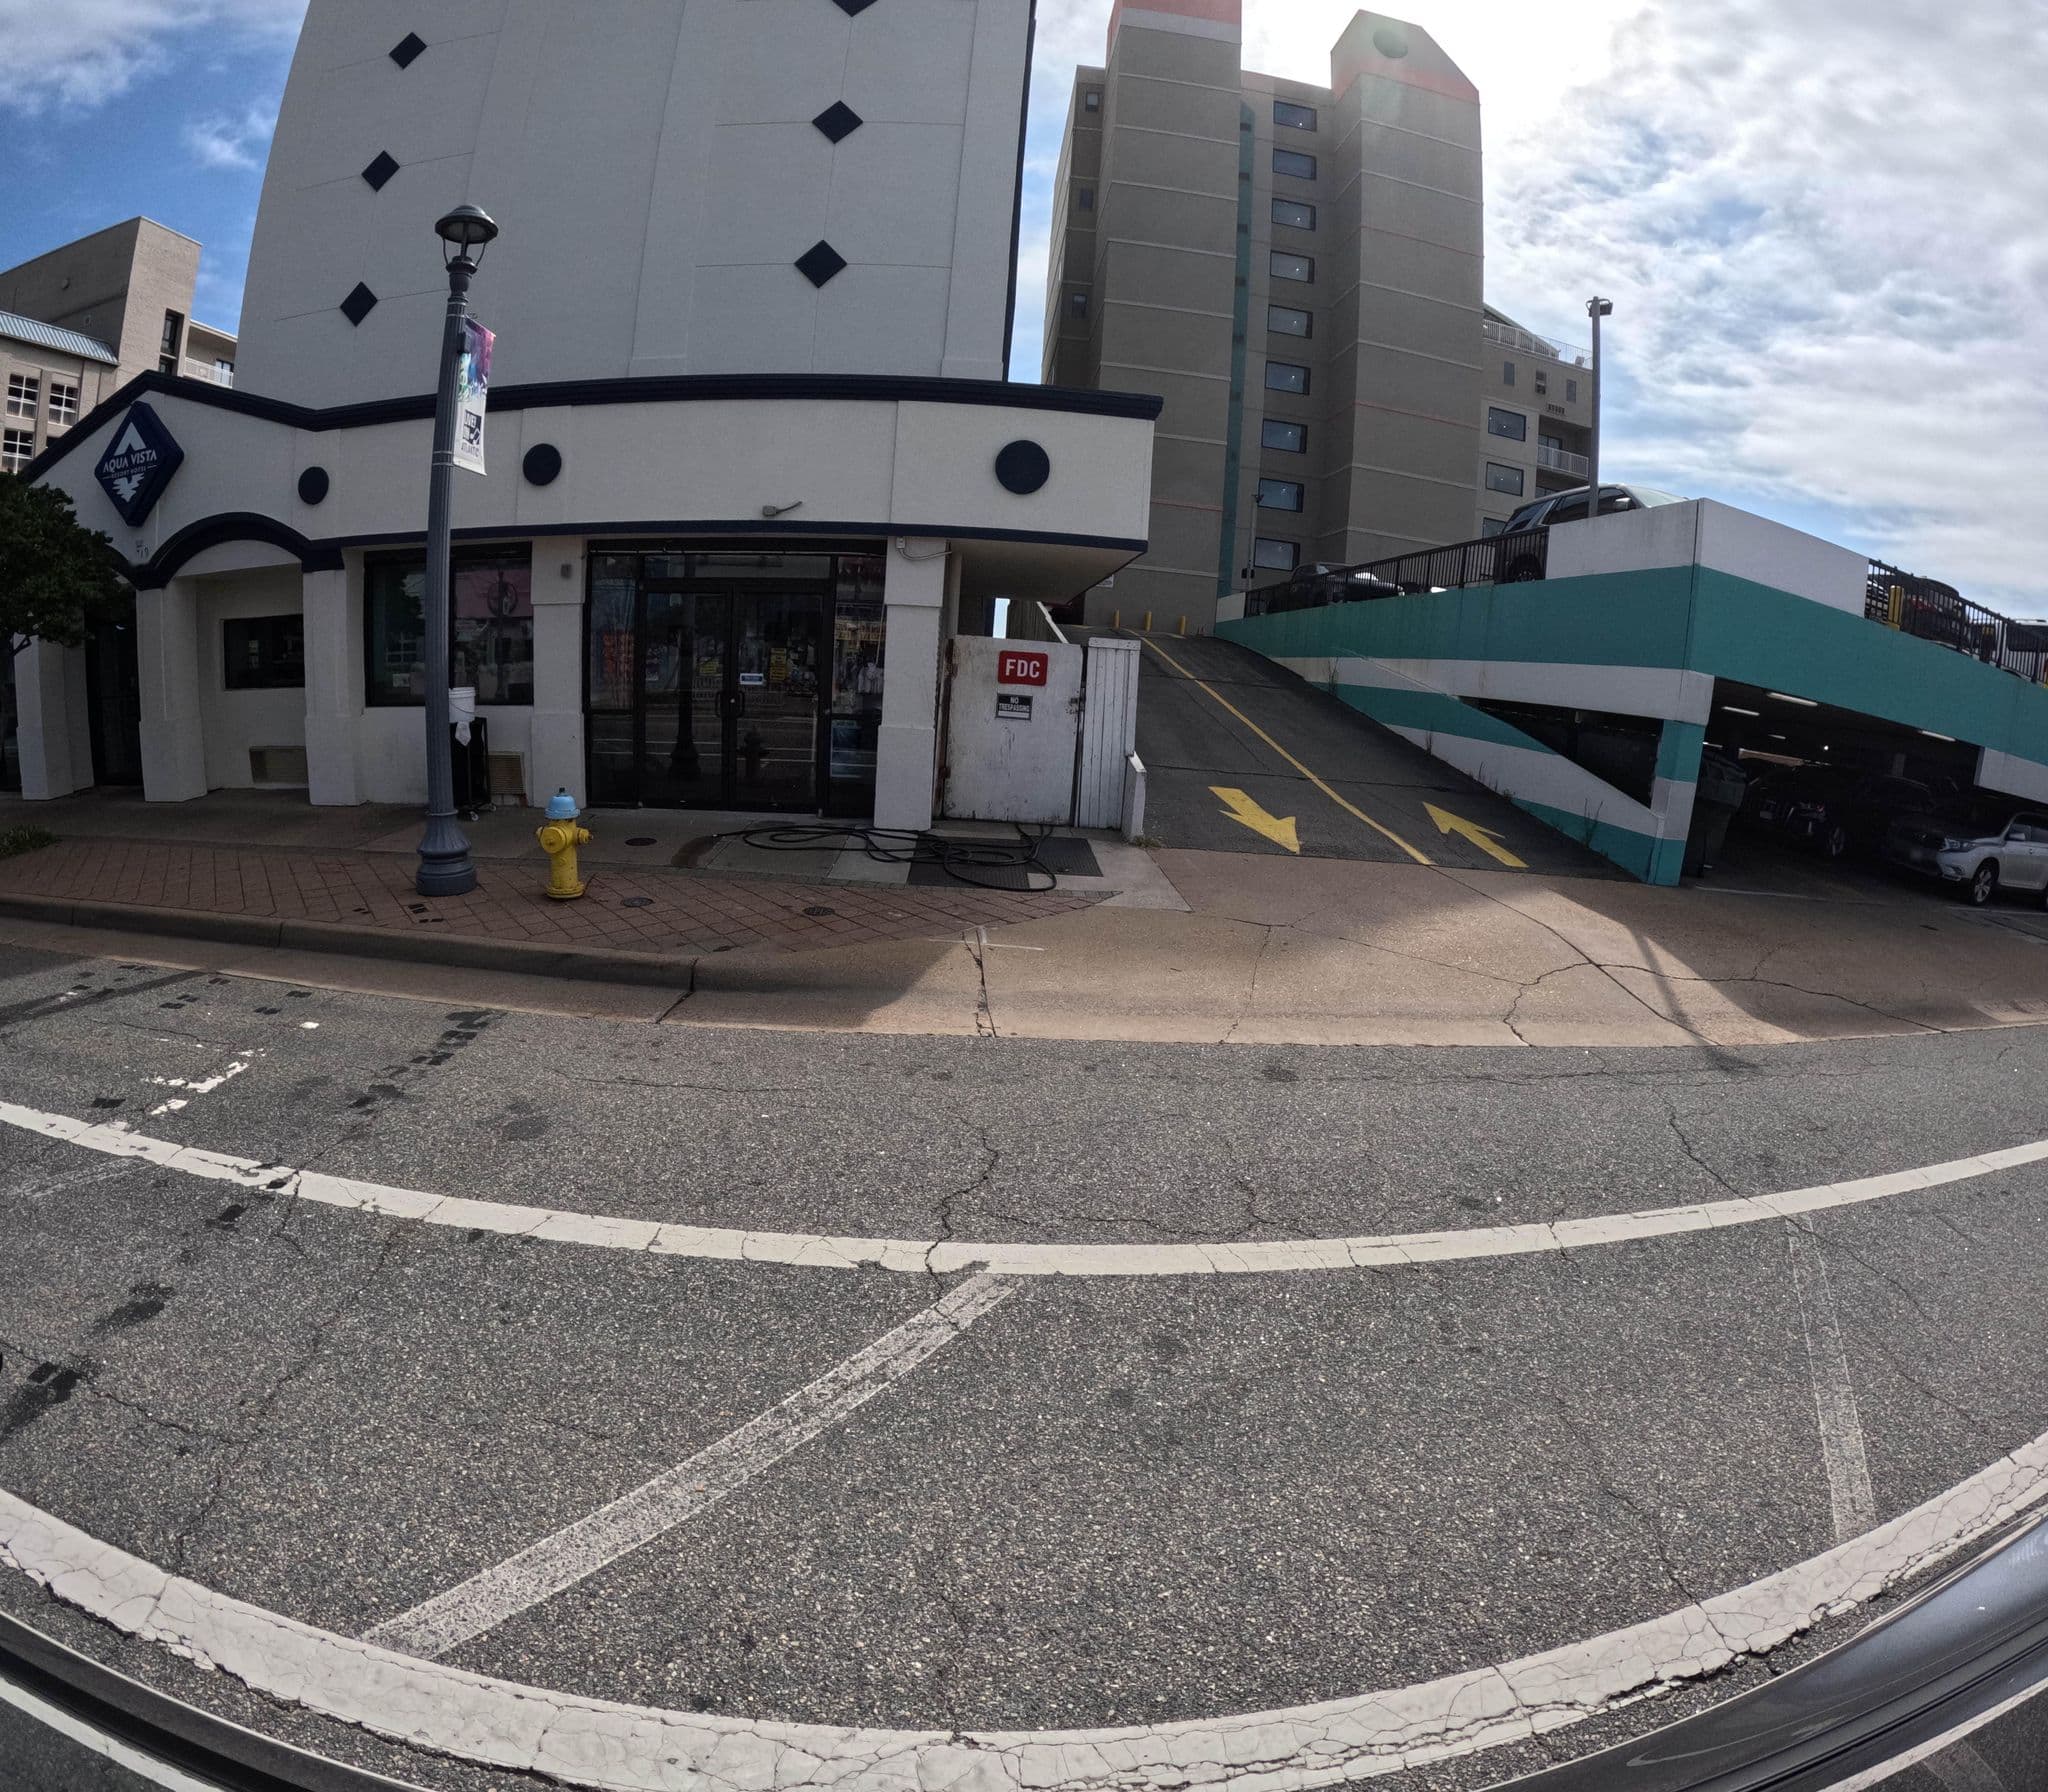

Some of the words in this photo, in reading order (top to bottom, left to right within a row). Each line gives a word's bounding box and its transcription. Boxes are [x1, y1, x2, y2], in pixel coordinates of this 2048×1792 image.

[103, 457, 129, 473] AQUA
[131, 449, 157, 464] VISTA
[1005, 658, 1040, 678] FDC
[1010, 696, 1019, 704] NO
